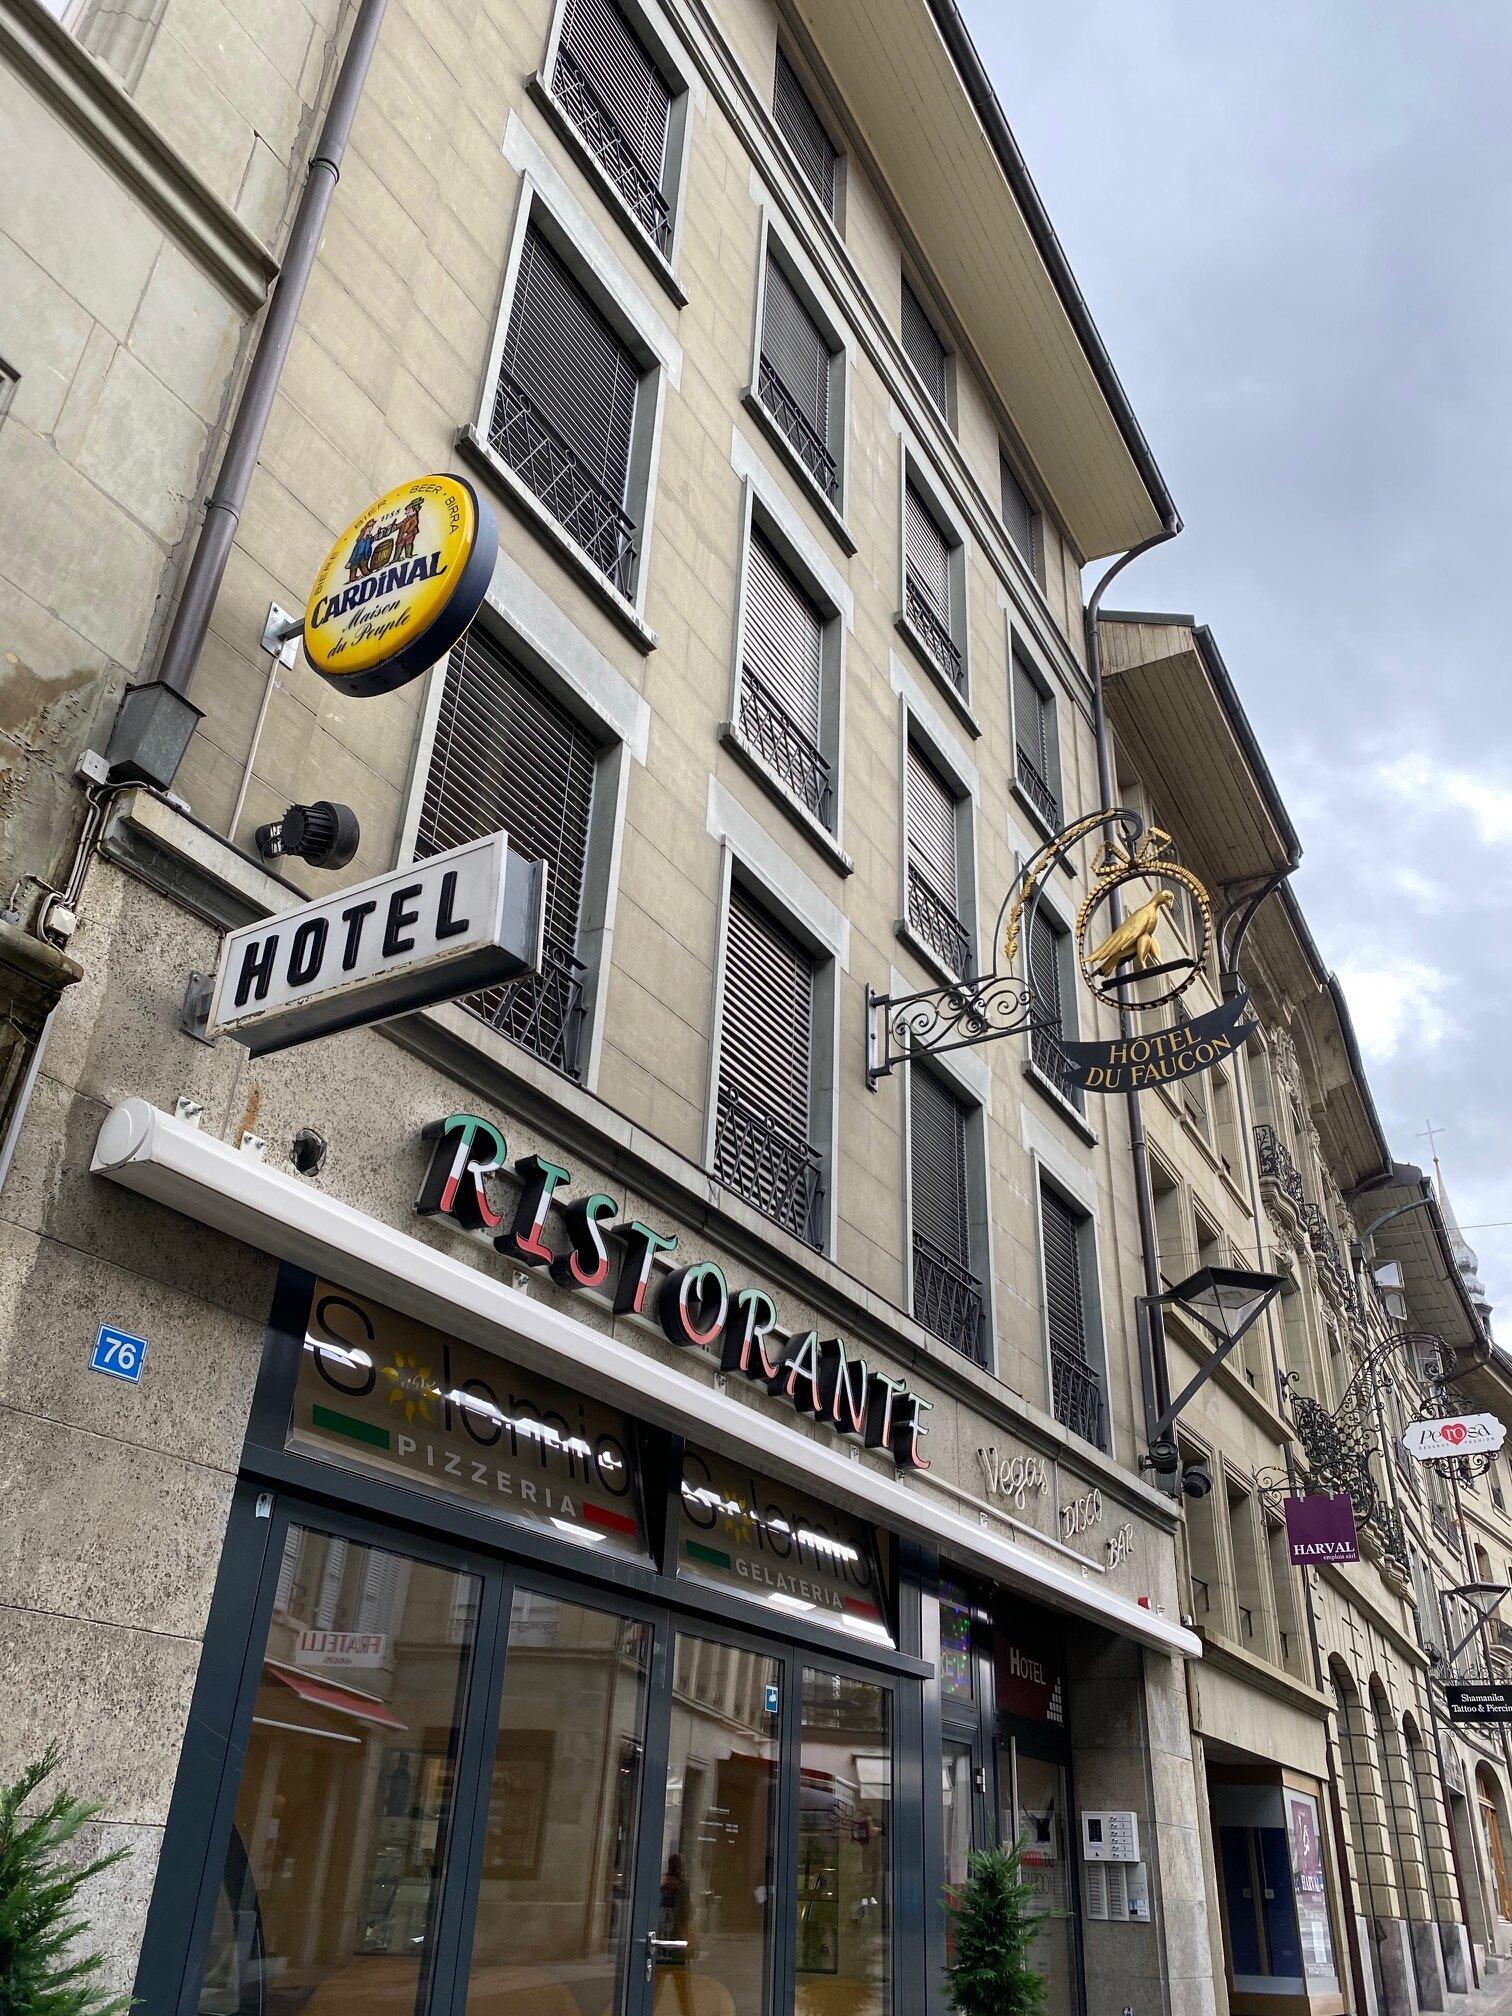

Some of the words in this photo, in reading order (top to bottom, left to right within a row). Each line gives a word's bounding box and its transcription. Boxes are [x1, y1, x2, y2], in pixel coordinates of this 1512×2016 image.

[409, 483, 443, 494] BEER
[444, 496, 460, 535] BIRRA
[327, 638, 348, 659] du
[351, 606, 412, 647] Peuple
[342, 600, 401, 633] Maison
[234, 871, 470, 1007] HOTEL
[1085, 1066, 1121, 1089] DU
[1130, 1033, 1232, 1087] FAUCON
[1108, 1028, 1202, 1065] HÔTEL
[418, 1113, 934, 1470] RISTORANTE
[104, 1337, 137, 1369] 76
[398, 1434, 577, 1518] PIZZERIA
[977, 1446, 1048, 1509] Vegas
[1061, 1488, 1101, 1539] DISCO
[1106, 1523, 1134, 1569] BAR
[1293, 1541, 1355, 1556] HARVAL
[735, 1558, 844, 1610] GELATERIA
[1009, 1647, 1046, 1685] HOTEL
[1451, 1704, 1477, 1713] Tattoo
[1478, 1705, 1485, 1713] &
[1460, 1693, 1505, 1702] Shamanika
